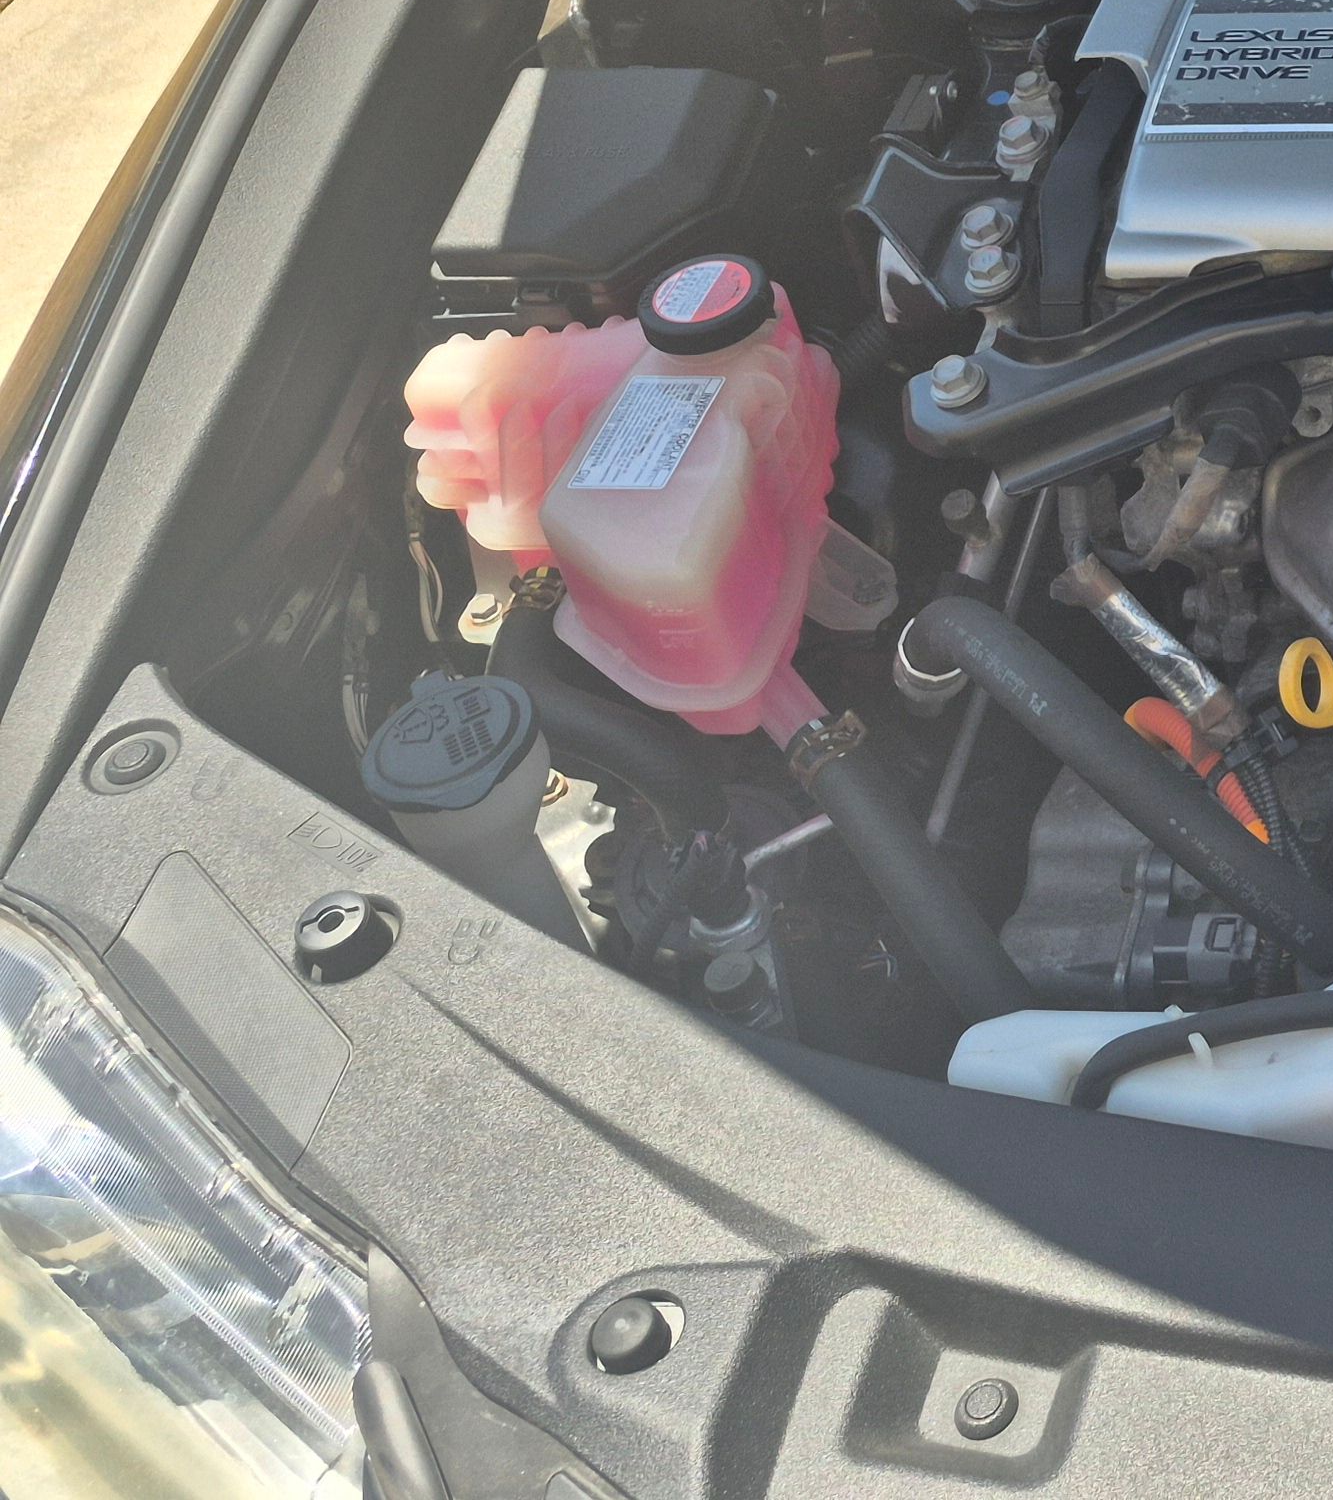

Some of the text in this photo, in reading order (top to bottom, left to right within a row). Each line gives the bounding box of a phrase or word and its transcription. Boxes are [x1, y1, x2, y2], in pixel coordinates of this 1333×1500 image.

[1175, 65, 1312, 81] DRIVE
[663, 392, 712, 471] INVERTER COOLANT
[336, 841, 378, 872] 1.0%
